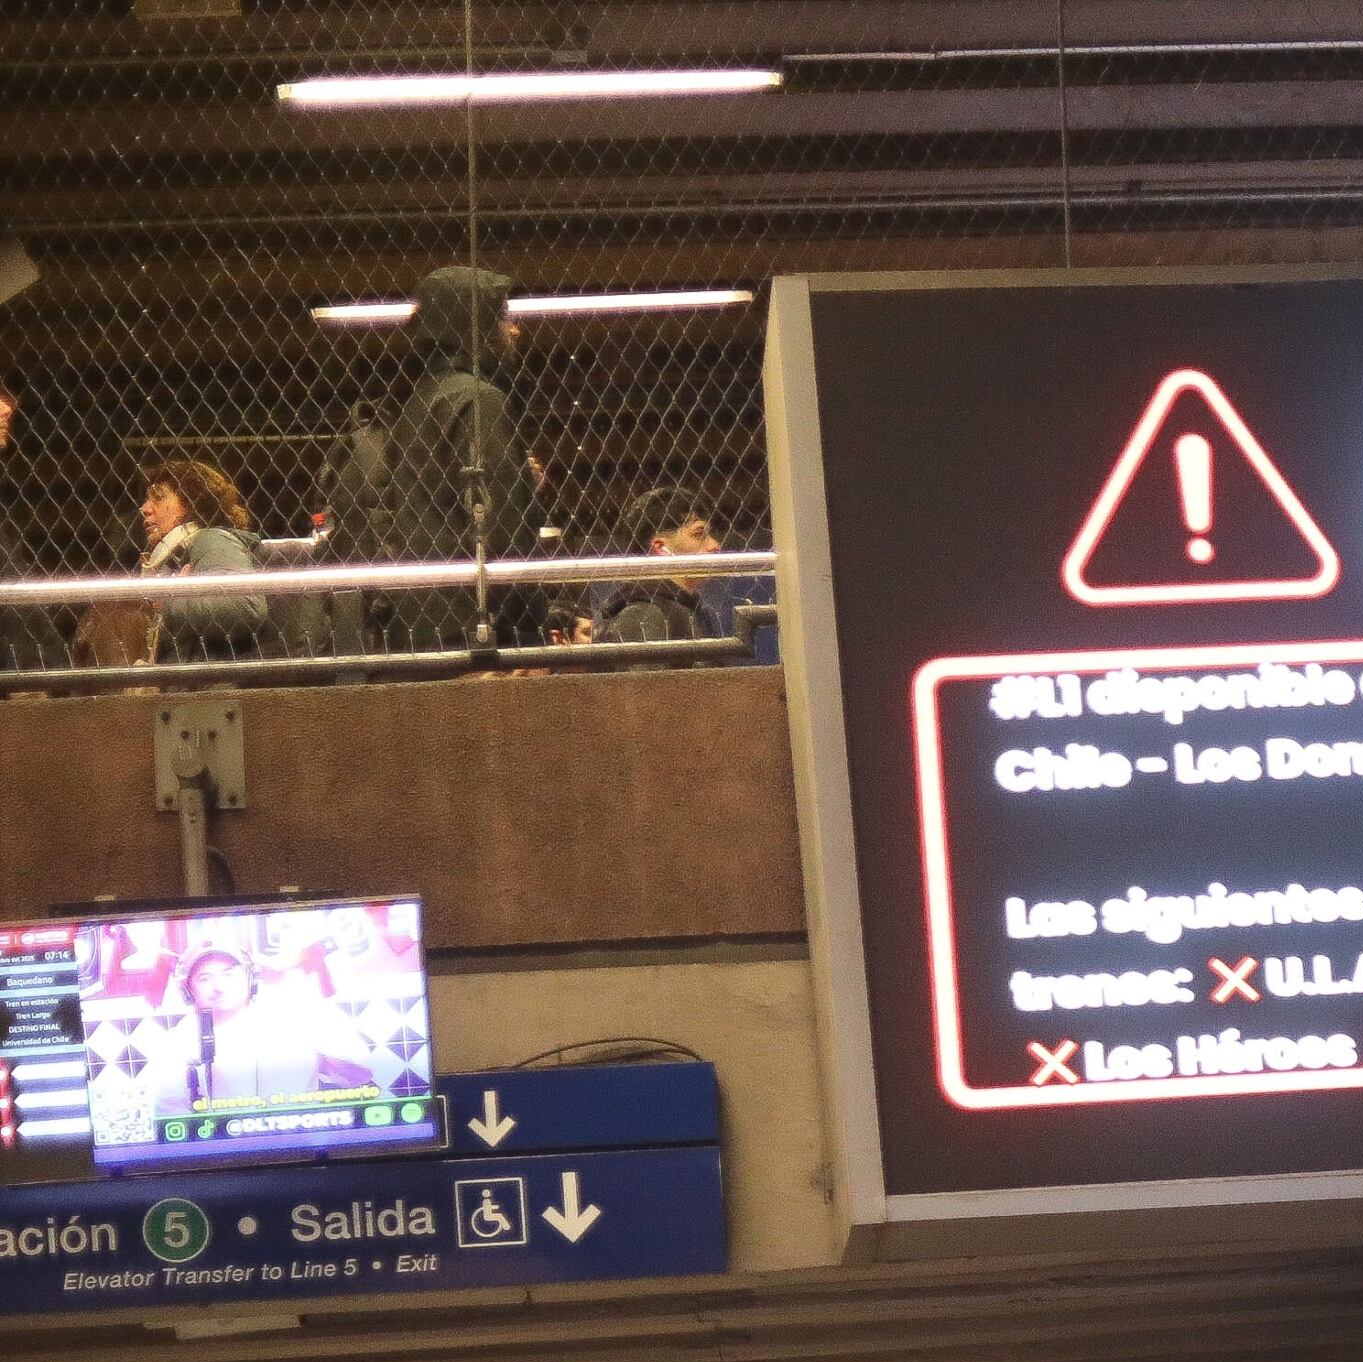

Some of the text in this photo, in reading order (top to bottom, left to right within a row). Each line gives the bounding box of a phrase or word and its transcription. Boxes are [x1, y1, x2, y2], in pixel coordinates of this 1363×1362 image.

[1087, 663, 1355, 723] disponible
[994, 743, 1133, 793] Chile
[1173, 742, 1263, 784] Los
[1005, 897, 1098, 939] Las
[44, 950, 70, 961] 07:14
[7, 976, 54, 988] Baquedano
[1009, 967, 1195, 1012] trenes:
[5, 1000, 20, 1008] Tren
[31, 998, 59, 1006] estación
[16, 1011, 51, 1020] Tren Largo
[2, 1037, 42, 1047] Universidad
[51, 1035, 70, 1044] Chile
[9, 1023, 61, 1034] DESTINO FINAL
[1083, 1038, 1173, 1083] Los
[1177, 1027, 1358, 1077] Héroes
[225, 1110, 352, 1137] @DLTSPORTS
[162, 1211, 191, 1248] 5
[290, 1199, 436, 1242] Salida
[63, 1252, 439, 1291] Elevator Transfer to Line 5 Exit
